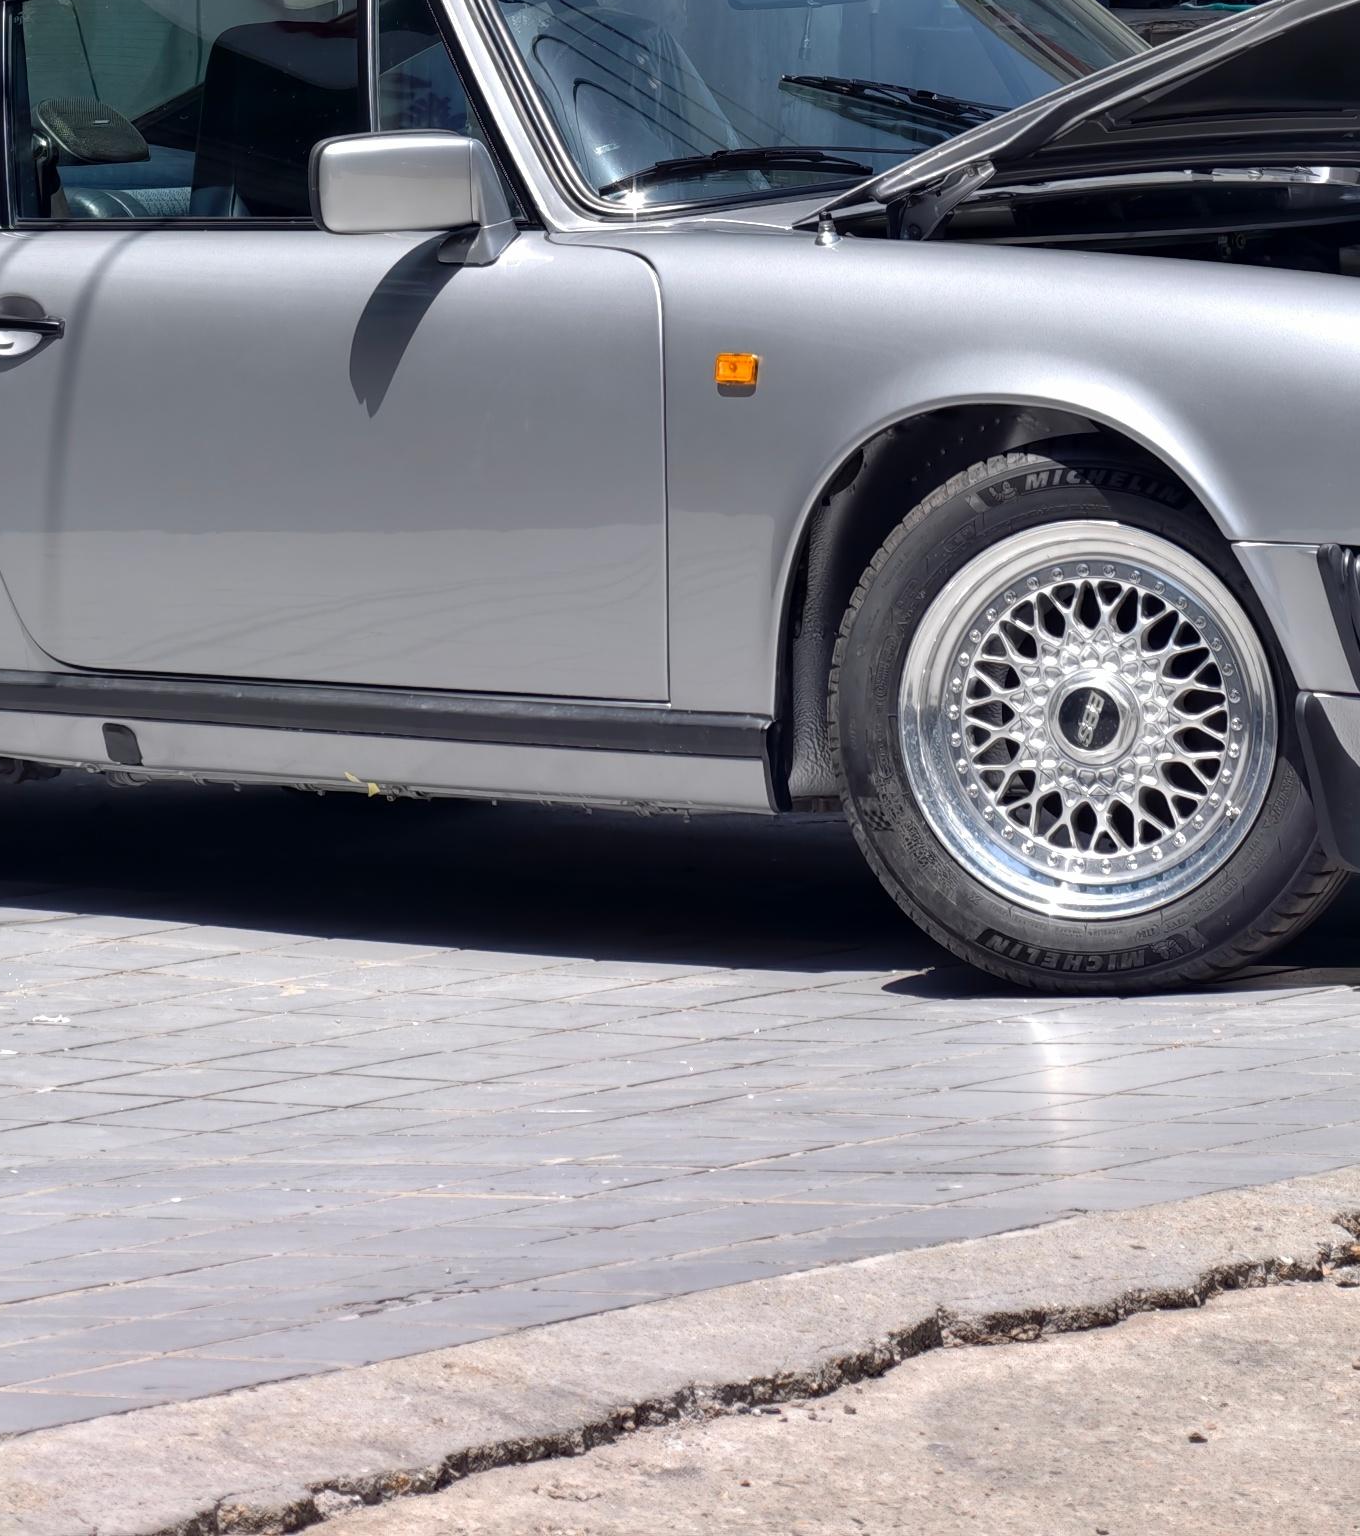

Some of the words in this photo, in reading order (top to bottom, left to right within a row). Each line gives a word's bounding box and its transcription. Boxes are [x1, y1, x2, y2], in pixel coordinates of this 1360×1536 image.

[1025, 467, 1186, 505] MICHELIN
[1077, 689, 1106, 748] BBS
[986, 932, 1145, 973] MICHELIN
